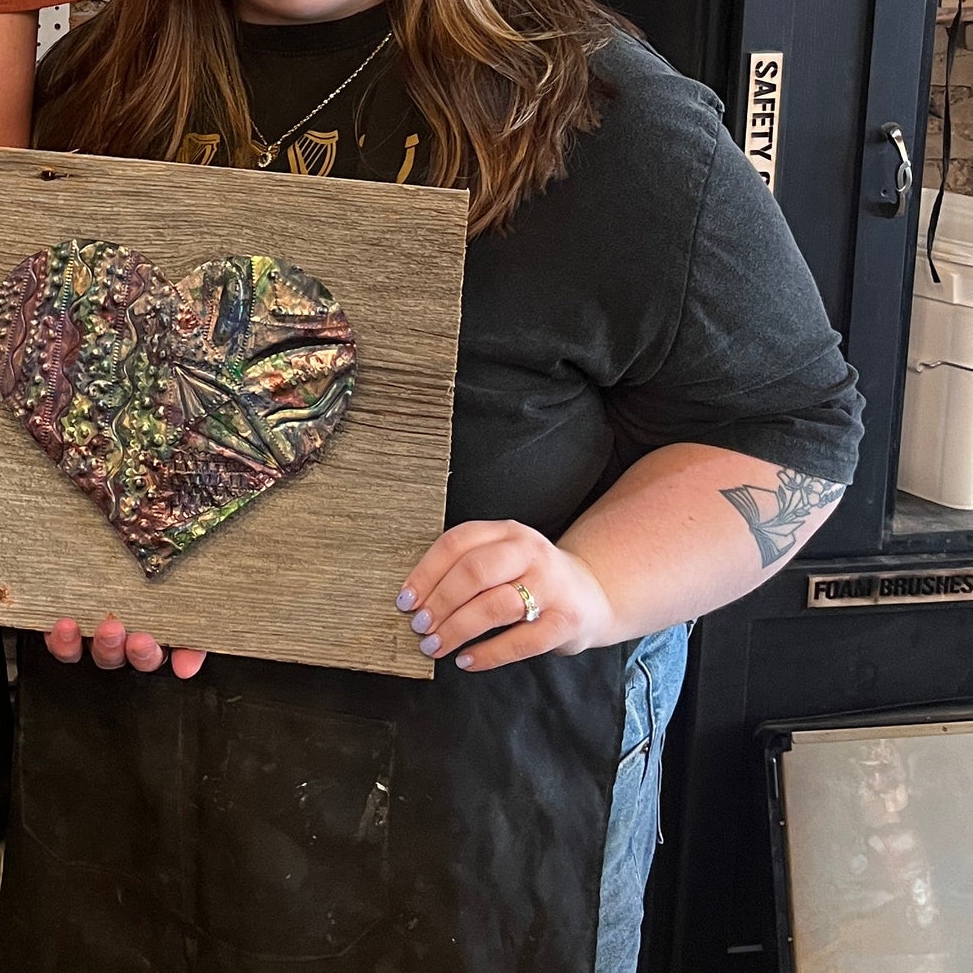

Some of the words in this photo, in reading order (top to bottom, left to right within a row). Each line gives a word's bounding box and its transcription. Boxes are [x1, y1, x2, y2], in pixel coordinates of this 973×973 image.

[749, 60, 779, 161] SAFETY
[813, 580, 873, 600] FOAM
[879, 574, 973, 597] BRUSHES
